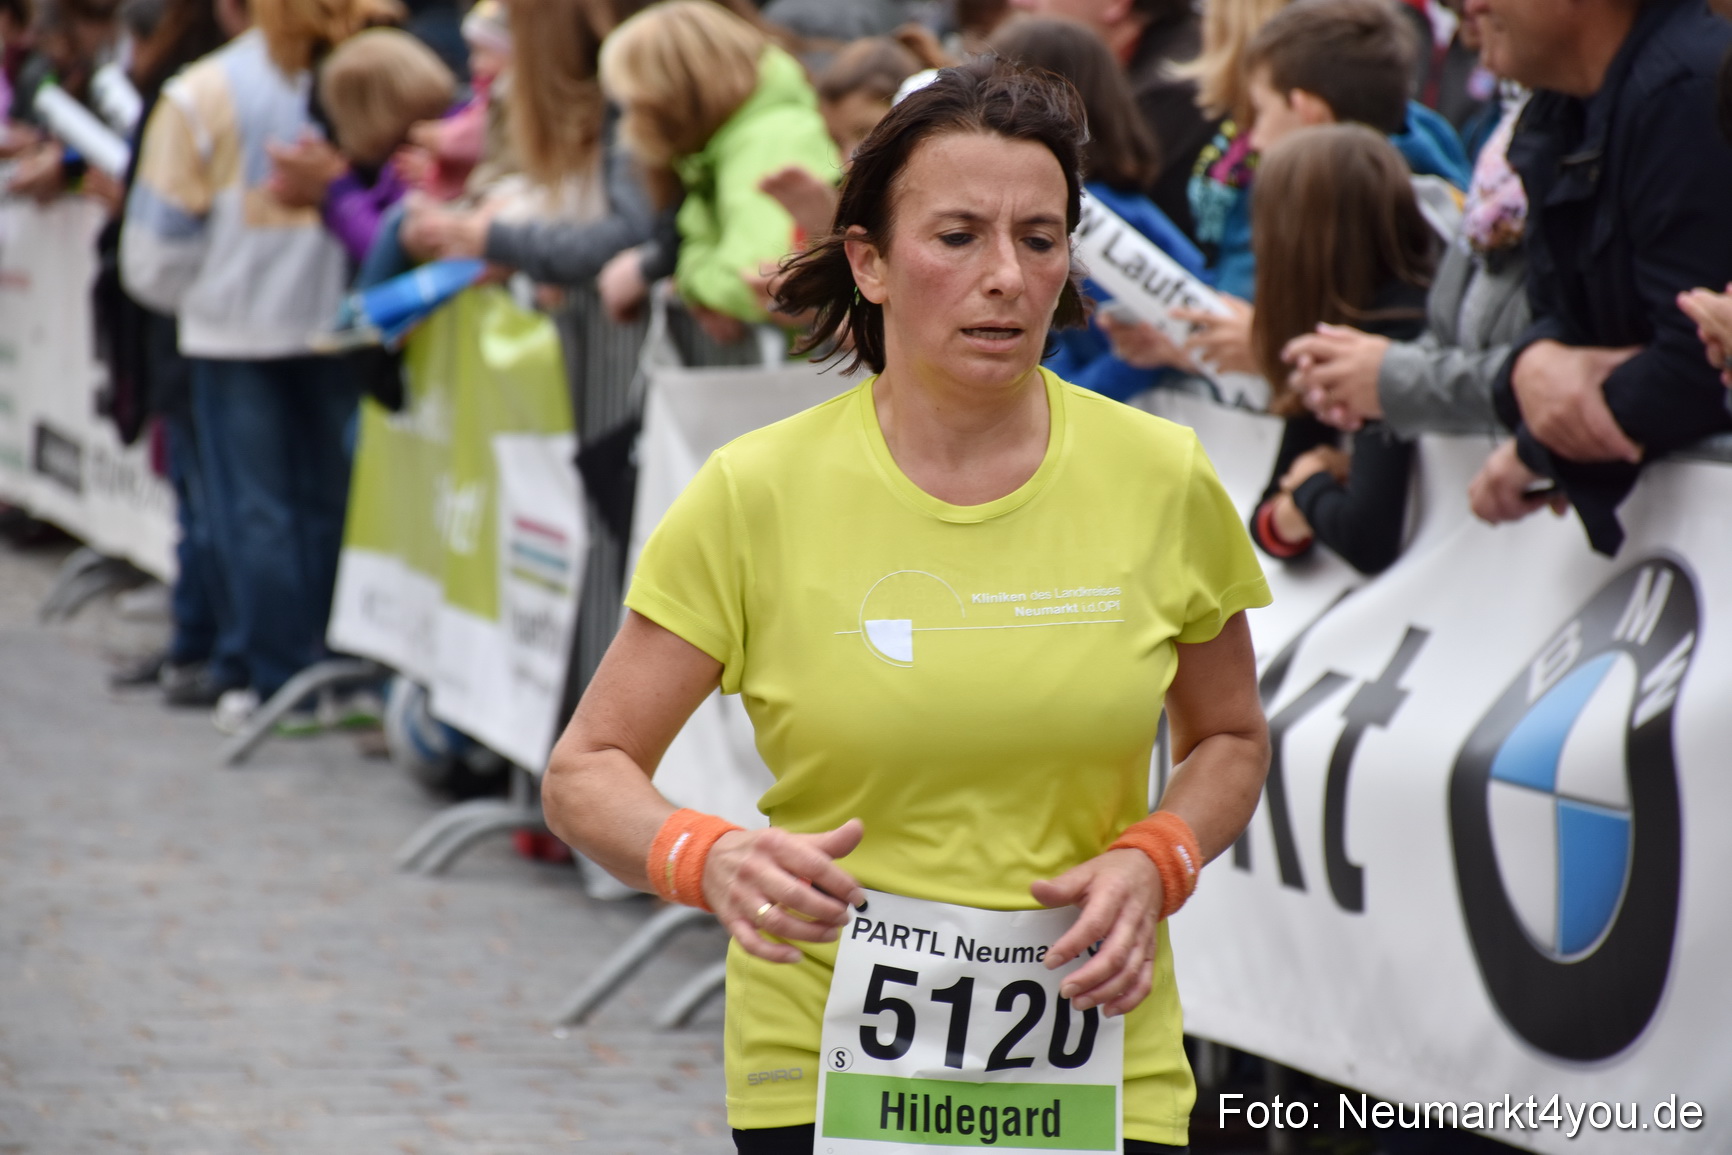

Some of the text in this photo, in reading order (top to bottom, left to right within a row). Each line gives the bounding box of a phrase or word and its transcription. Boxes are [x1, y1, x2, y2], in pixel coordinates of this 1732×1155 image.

[1100, 228, 1203, 310] Laufs
[971, 586, 1121, 604] Kliniken des Landkreises
[1014, 603, 1079, 617] Neumarkt
[1526, 565, 1695, 730] BMW
[850, 916, 1050, 964] PARTL Neuma
[858, 963, 1100, 1073] 5120
[747, 1067, 803, 1086] SPIRO
[833, 1050, 846, 1069] S
[879, 1090, 1061, 1145] Hildegard
